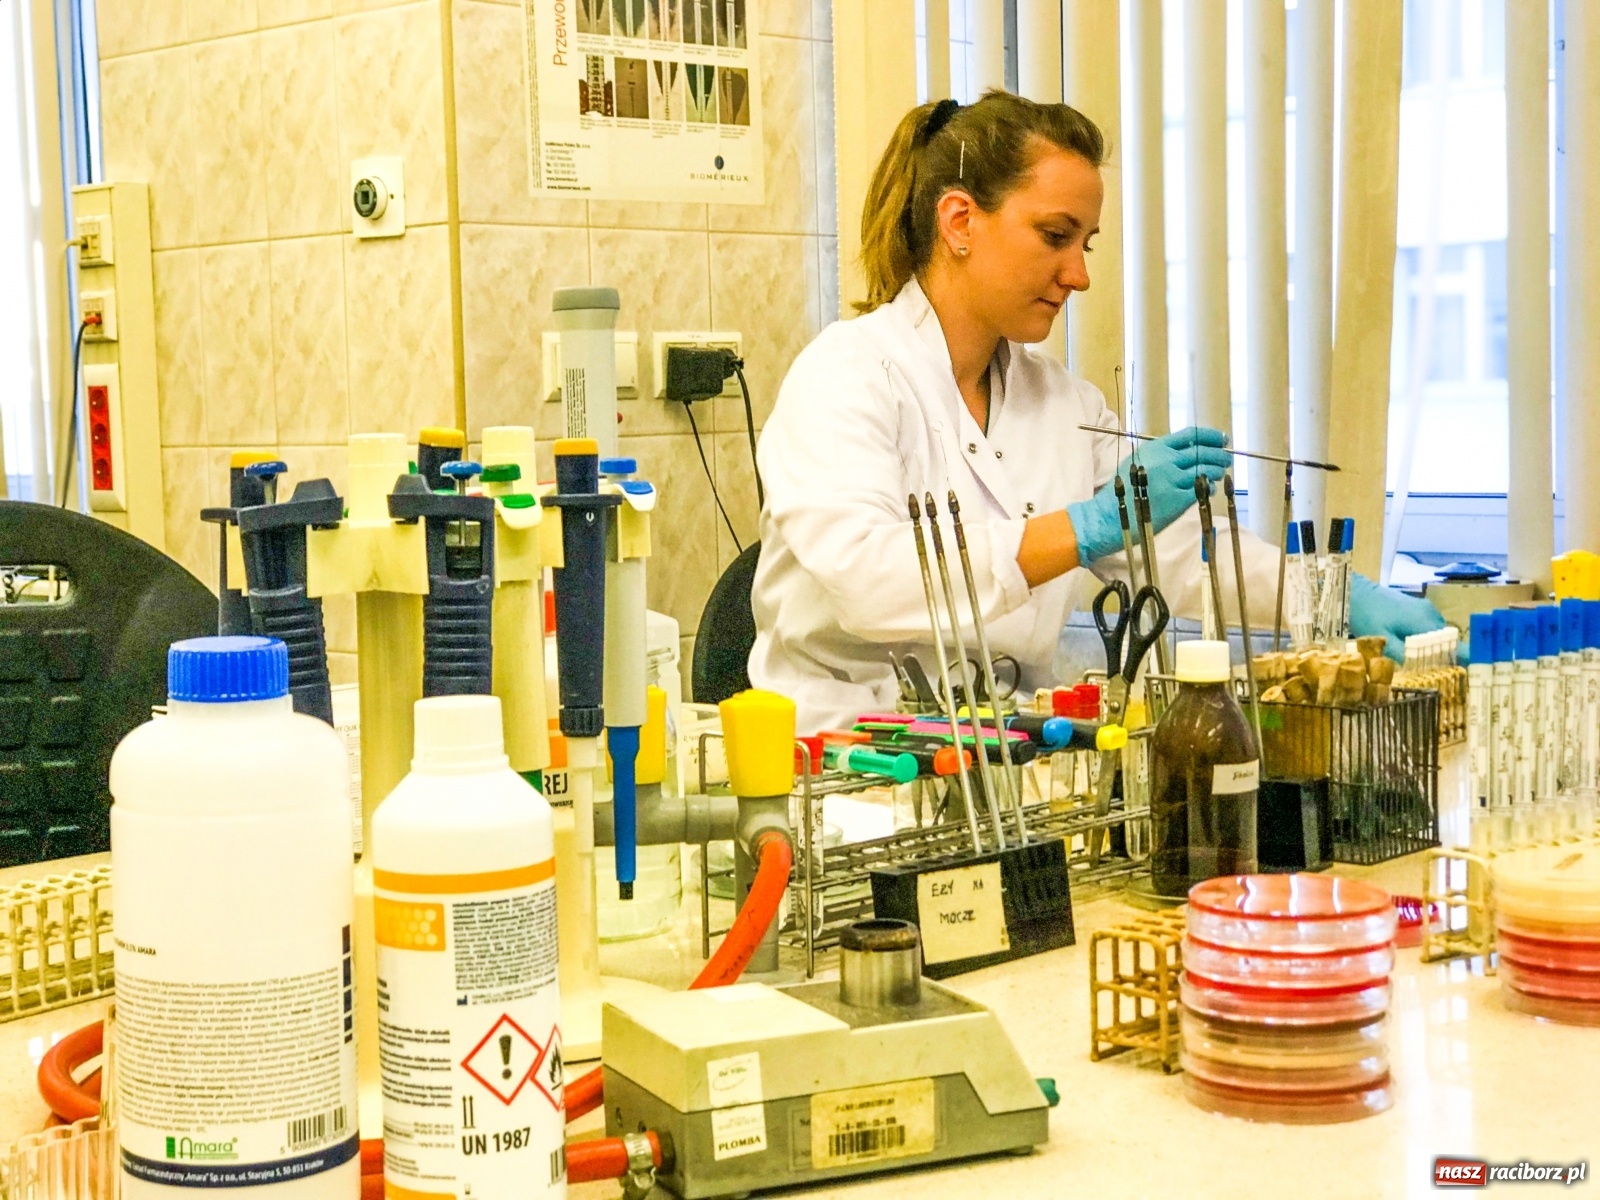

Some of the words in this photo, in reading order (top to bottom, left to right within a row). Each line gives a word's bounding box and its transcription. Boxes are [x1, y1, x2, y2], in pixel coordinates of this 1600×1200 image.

[553, 0, 567, 66] Przewo
[137, 946, 156, 955] AMARA
[462, 1134, 487, 1156] UN
[493, 1127, 531, 1153] 1987
[718, 1135, 761, 1152] PLOMBA
